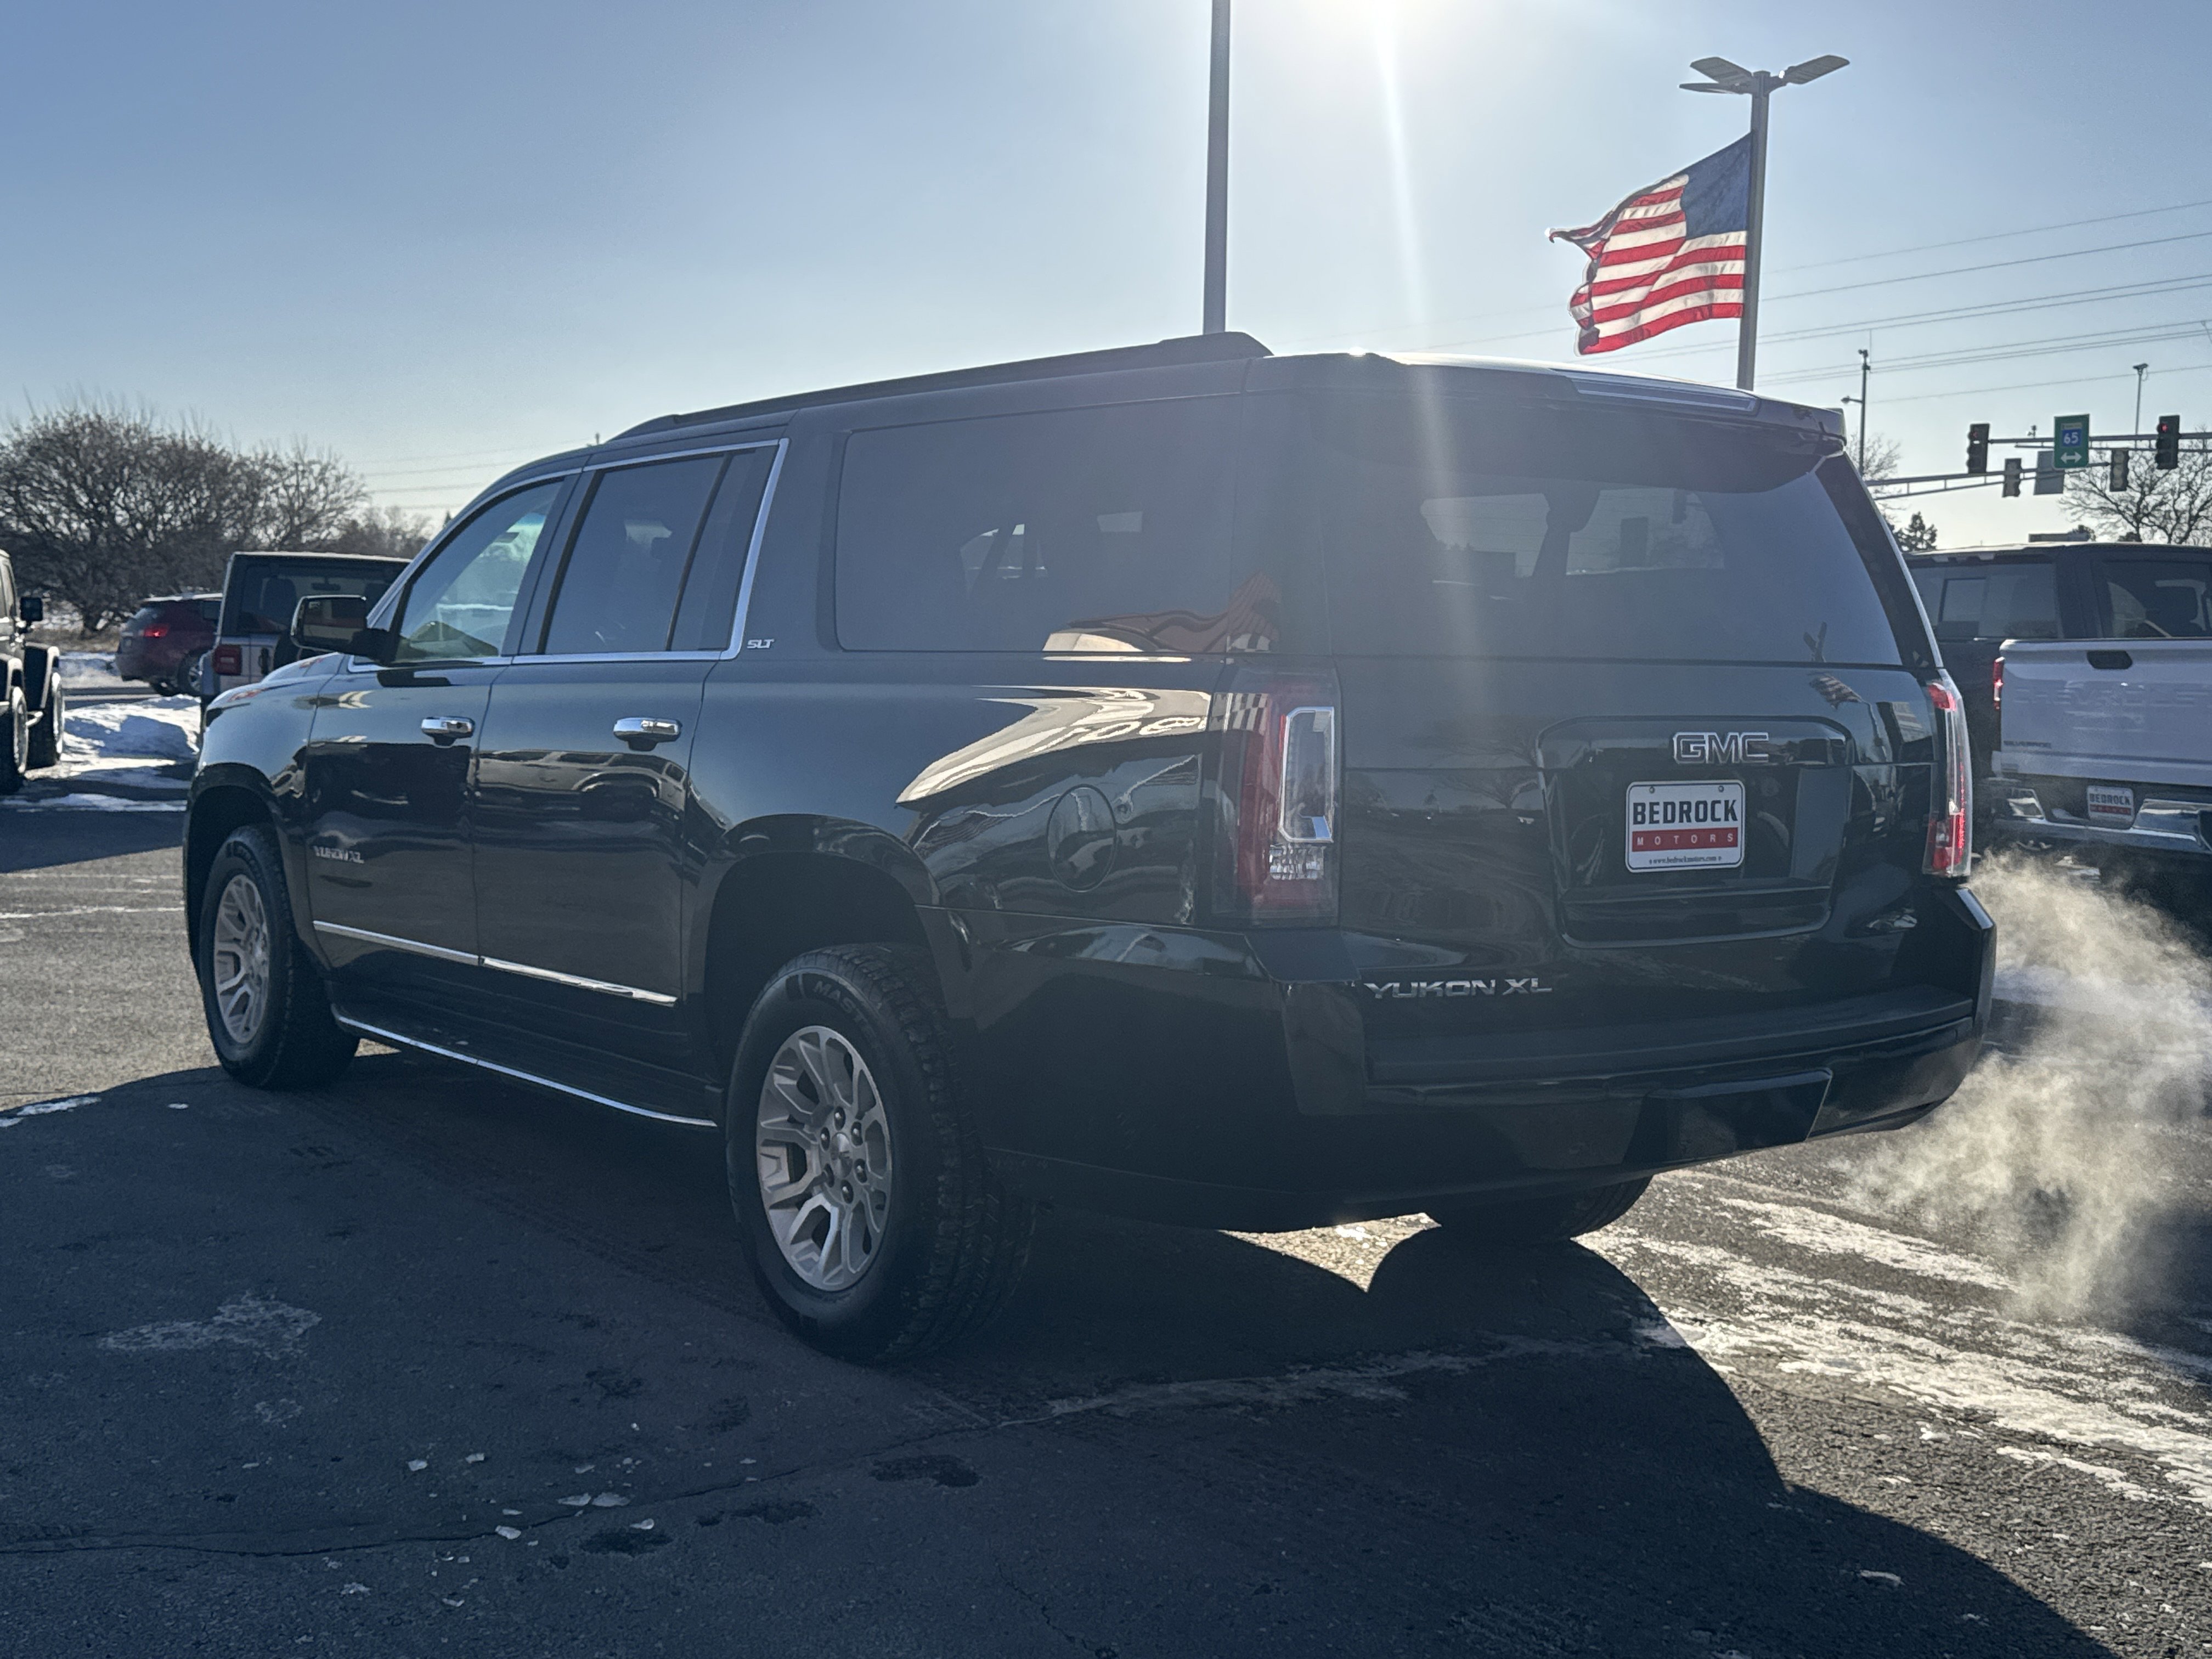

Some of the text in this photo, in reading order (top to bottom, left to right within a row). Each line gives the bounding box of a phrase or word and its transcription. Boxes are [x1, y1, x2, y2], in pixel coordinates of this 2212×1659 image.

[2064, 432, 2079, 444] 65
[747, 639, 775, 648] SLT
[1673, 732, 1769, 764] GMC
[2089, 793, 2131, 805] BEDROCK
[1633, 799, 1738, 825] BEDROCK
[1637, 833, 1734, 846] MOTORS
[1363, 978, 1553, 999] YUKON XL
